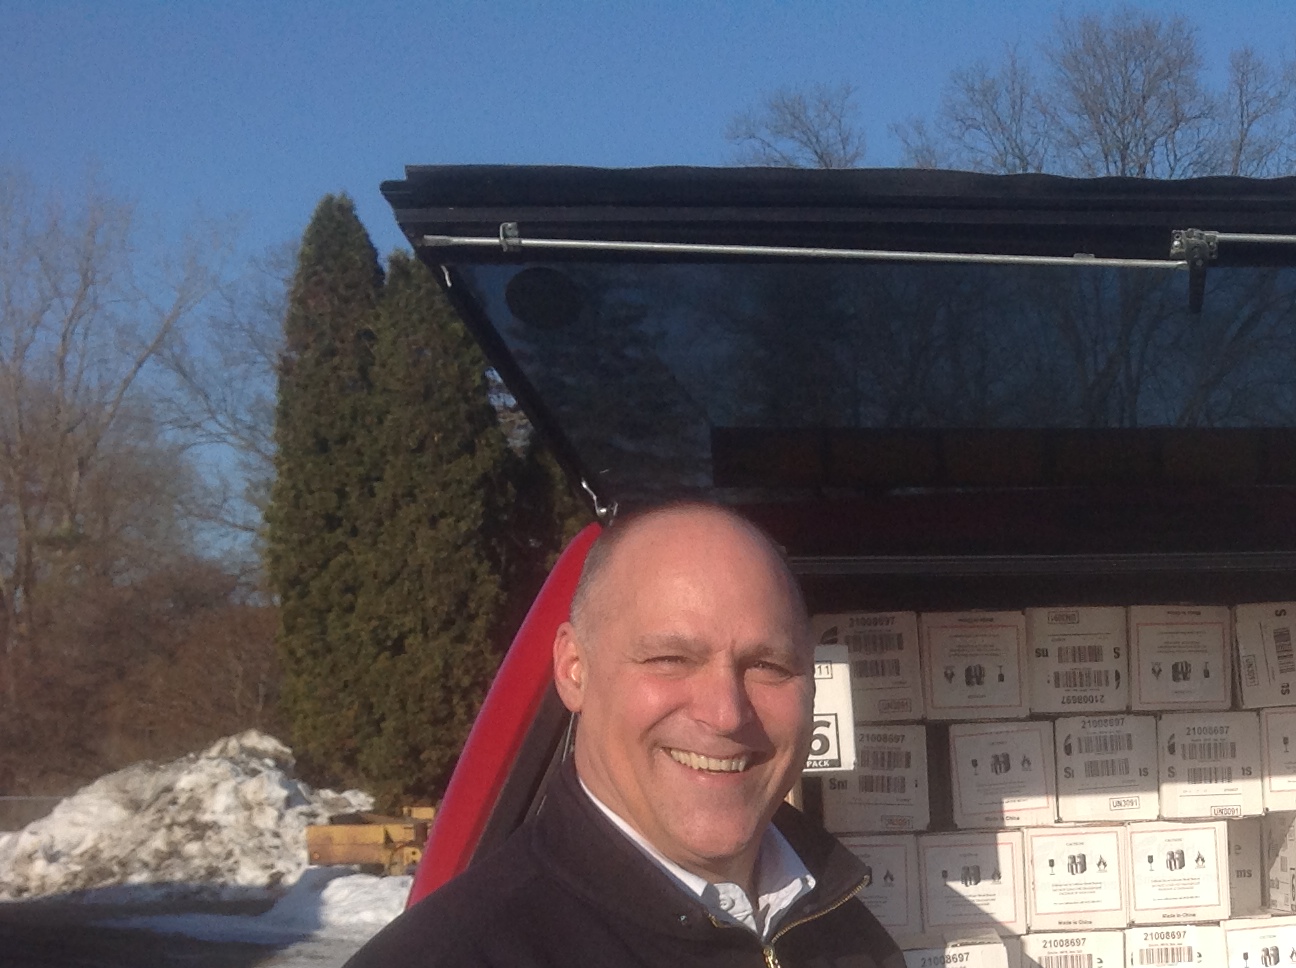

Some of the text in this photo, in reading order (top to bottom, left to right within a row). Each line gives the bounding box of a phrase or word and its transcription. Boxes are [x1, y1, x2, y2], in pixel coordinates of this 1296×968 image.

[1186, 726, 1230, 736] 21008697
[812, 720, 831, 756] 6
[1143, 931, 1187, 941] 21008697
[1042, 938, 1087, 949] 21008697
[920, 952, 970, 967] 21008697
